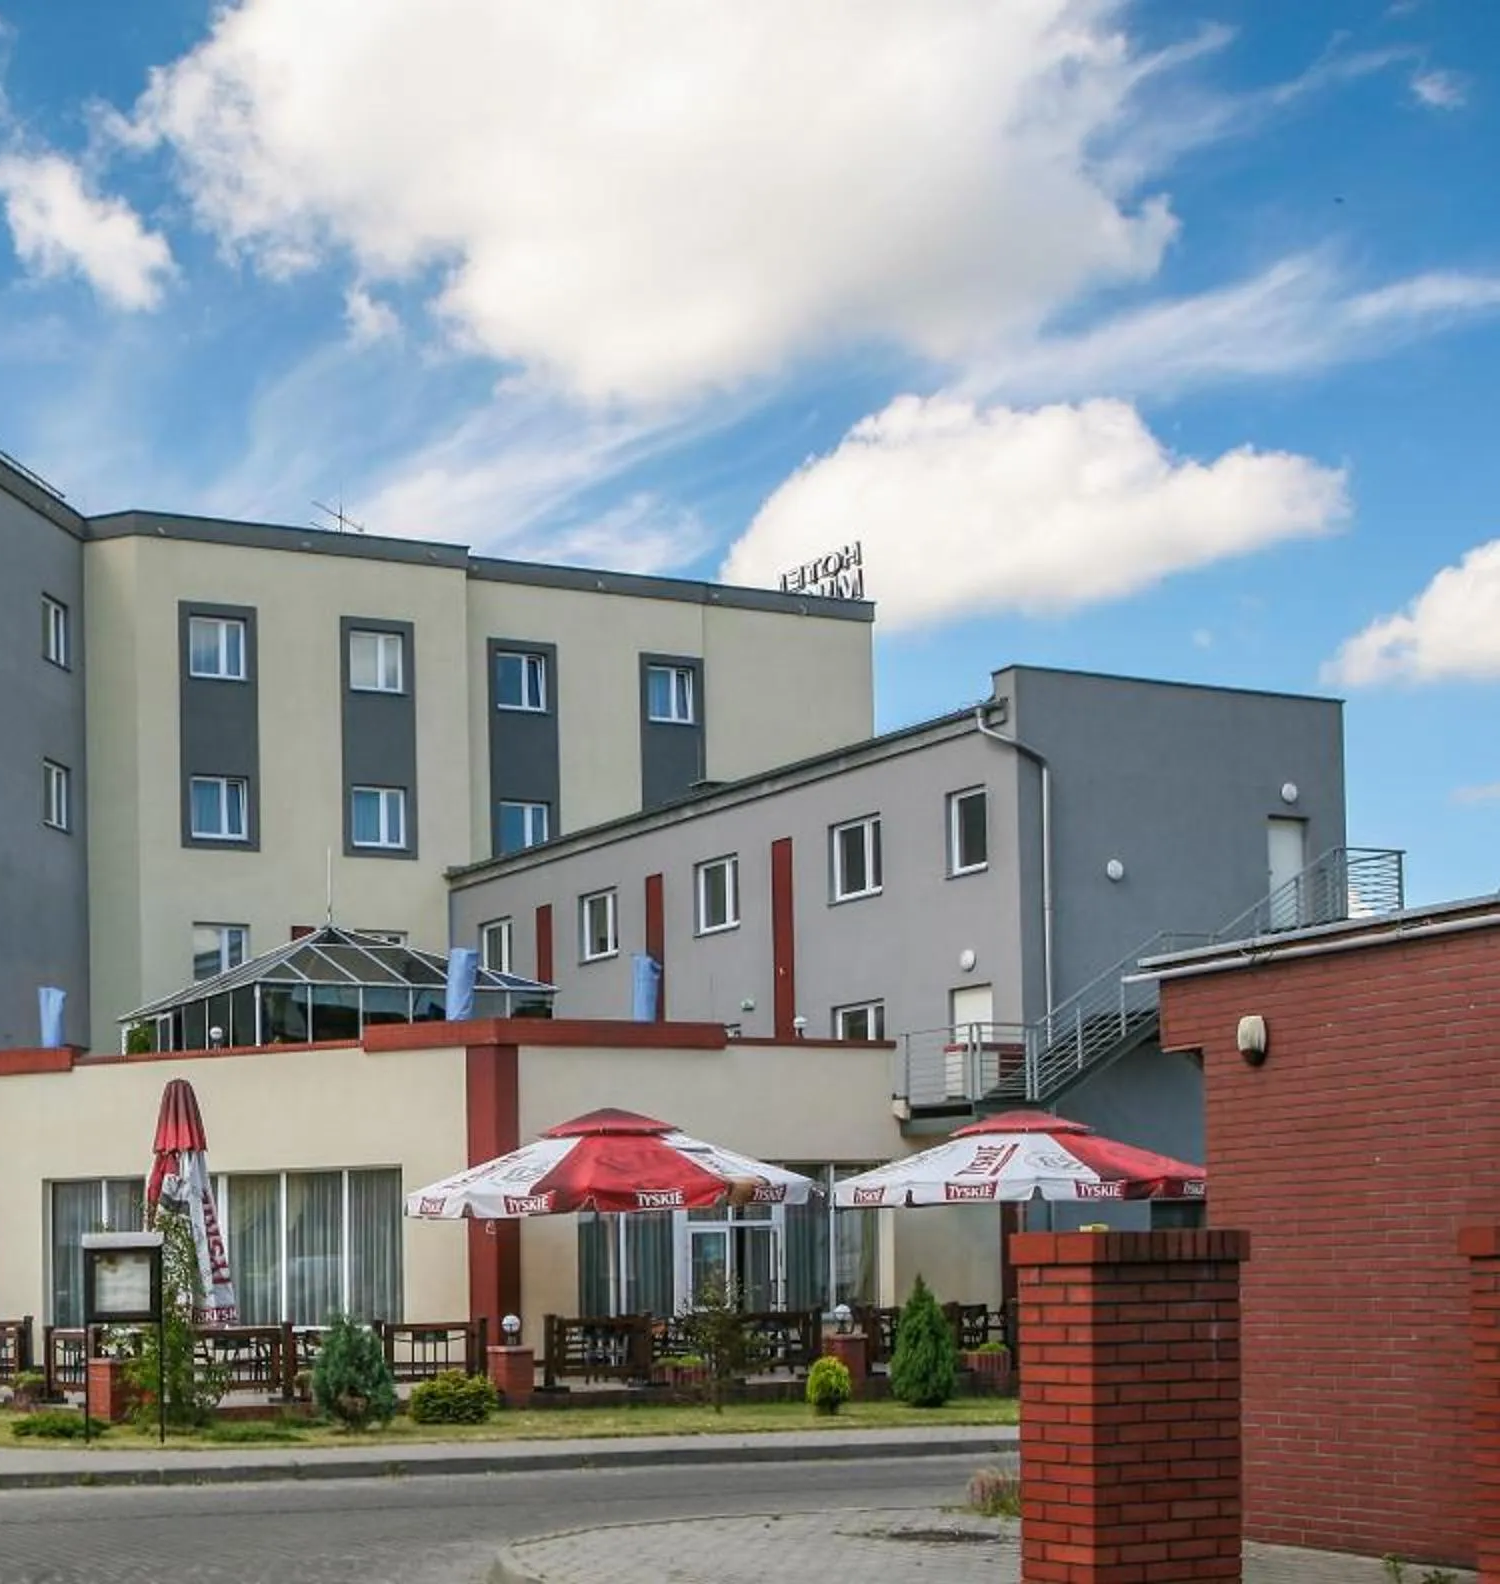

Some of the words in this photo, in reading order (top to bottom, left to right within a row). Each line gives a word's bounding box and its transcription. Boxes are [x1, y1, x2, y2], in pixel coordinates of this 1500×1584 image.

[947, 1184, 993, 1199] TYSKIE
[1079, 1181, 1124, 1196] TYSKIE
[507, 1195, 549, 1212] TYSKIE
[636, 1190, 684, 1207] TYSKIE
